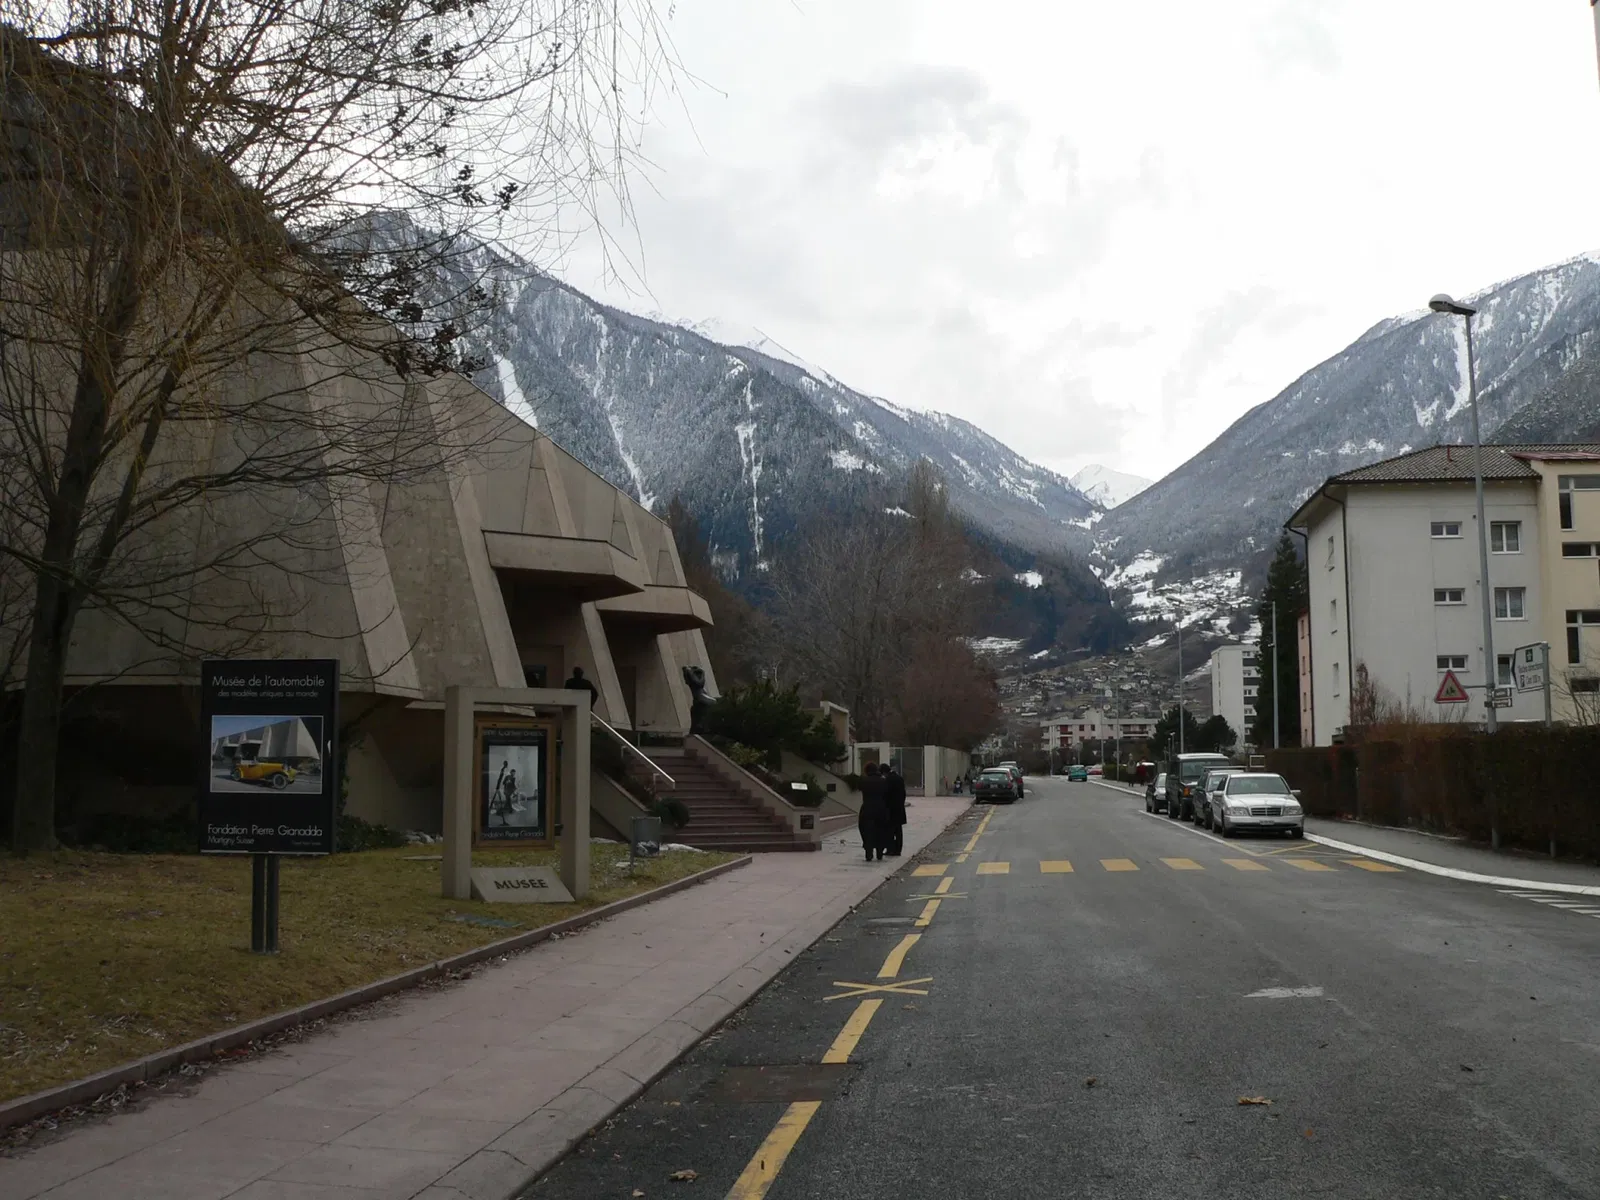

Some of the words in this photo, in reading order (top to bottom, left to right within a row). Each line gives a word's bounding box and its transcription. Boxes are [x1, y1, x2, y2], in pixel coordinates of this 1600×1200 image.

[212, 675, 246, 686] Musée
[248, 674, 262, 687] de
[265, 674, 325, 687] l'automobile
[218, 689, 229, 697] des
[231, 689, 258, 697] modèles
[259, 690, 284, 699] uniques
[295, 689, 319, 697] monde
[208, 823, 248, 835] Fondation
[252, 824, 274, 835] Pierre
[278, 824, 323, 836] Gianadda
[208, 835, 235, 846] Martigny
[236, 835, 255, 845] Suisse
[494, 879, 549, 890] MUSEE
